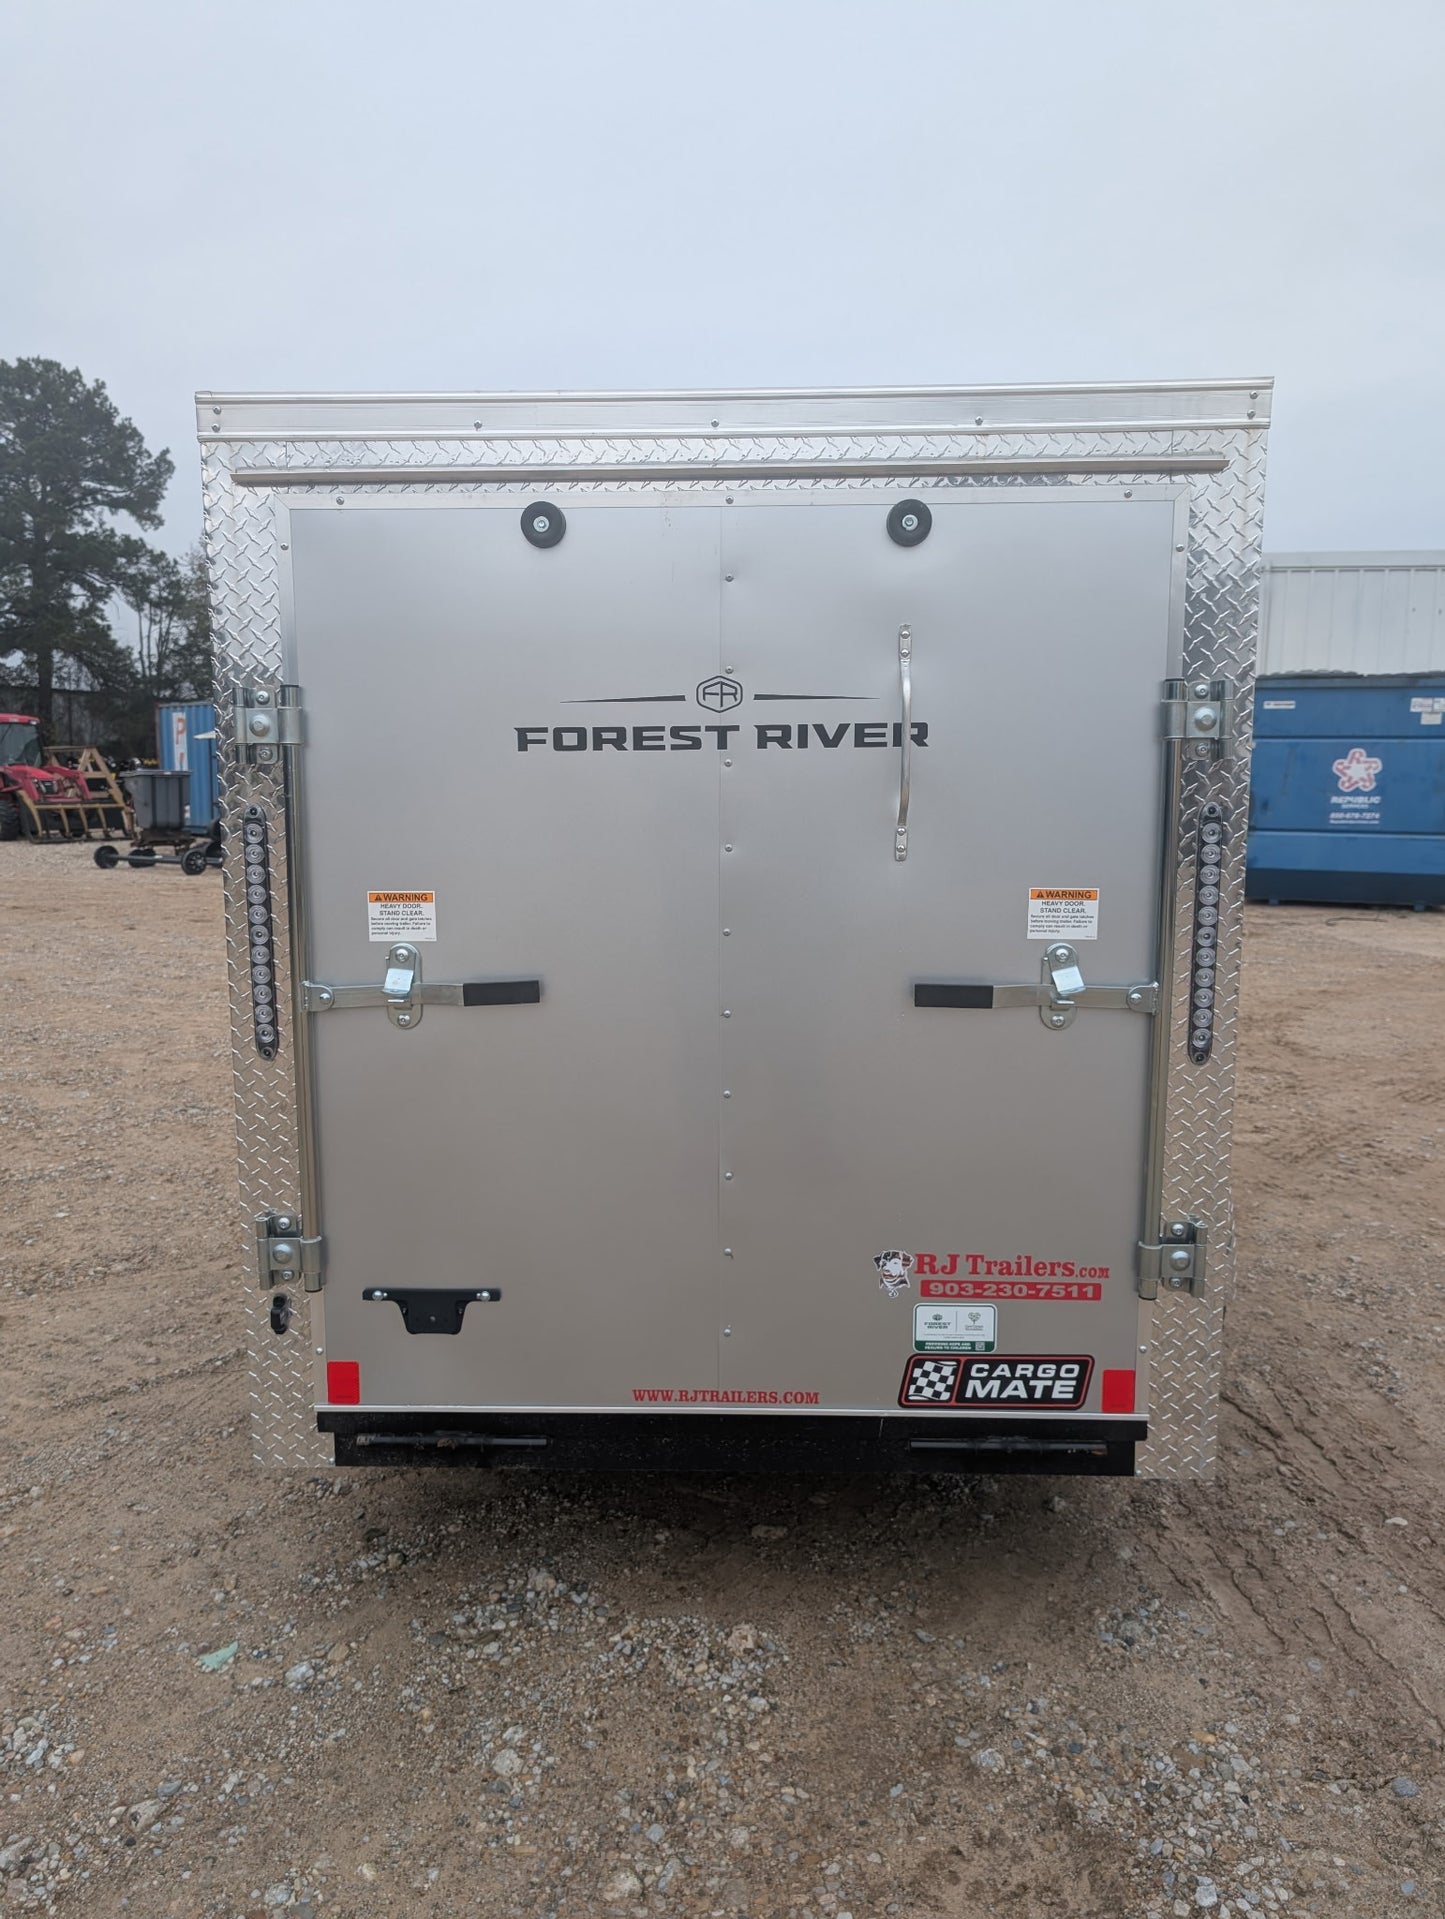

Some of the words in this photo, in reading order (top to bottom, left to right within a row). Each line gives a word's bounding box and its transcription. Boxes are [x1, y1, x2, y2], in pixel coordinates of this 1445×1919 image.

[513, 725, 740, 752] FOREST
[754, 722, 930, 749] RIVER
[1330, 796, 1381, 804] REPUBLIC
[383, 893, 428, 901] WARNING
[1046, 891, 1092, 899] WARNING
[914, 1253, 960, 1275] RJ
[929, 1282, 1095, 1298] 903-230-7511
[970, 1363, 1080, 1378] CARGO
[632, 1389, 820, 1405] WWW.RJTRAILERS.COM
[965, 1379, 1077, 1399] MATE
